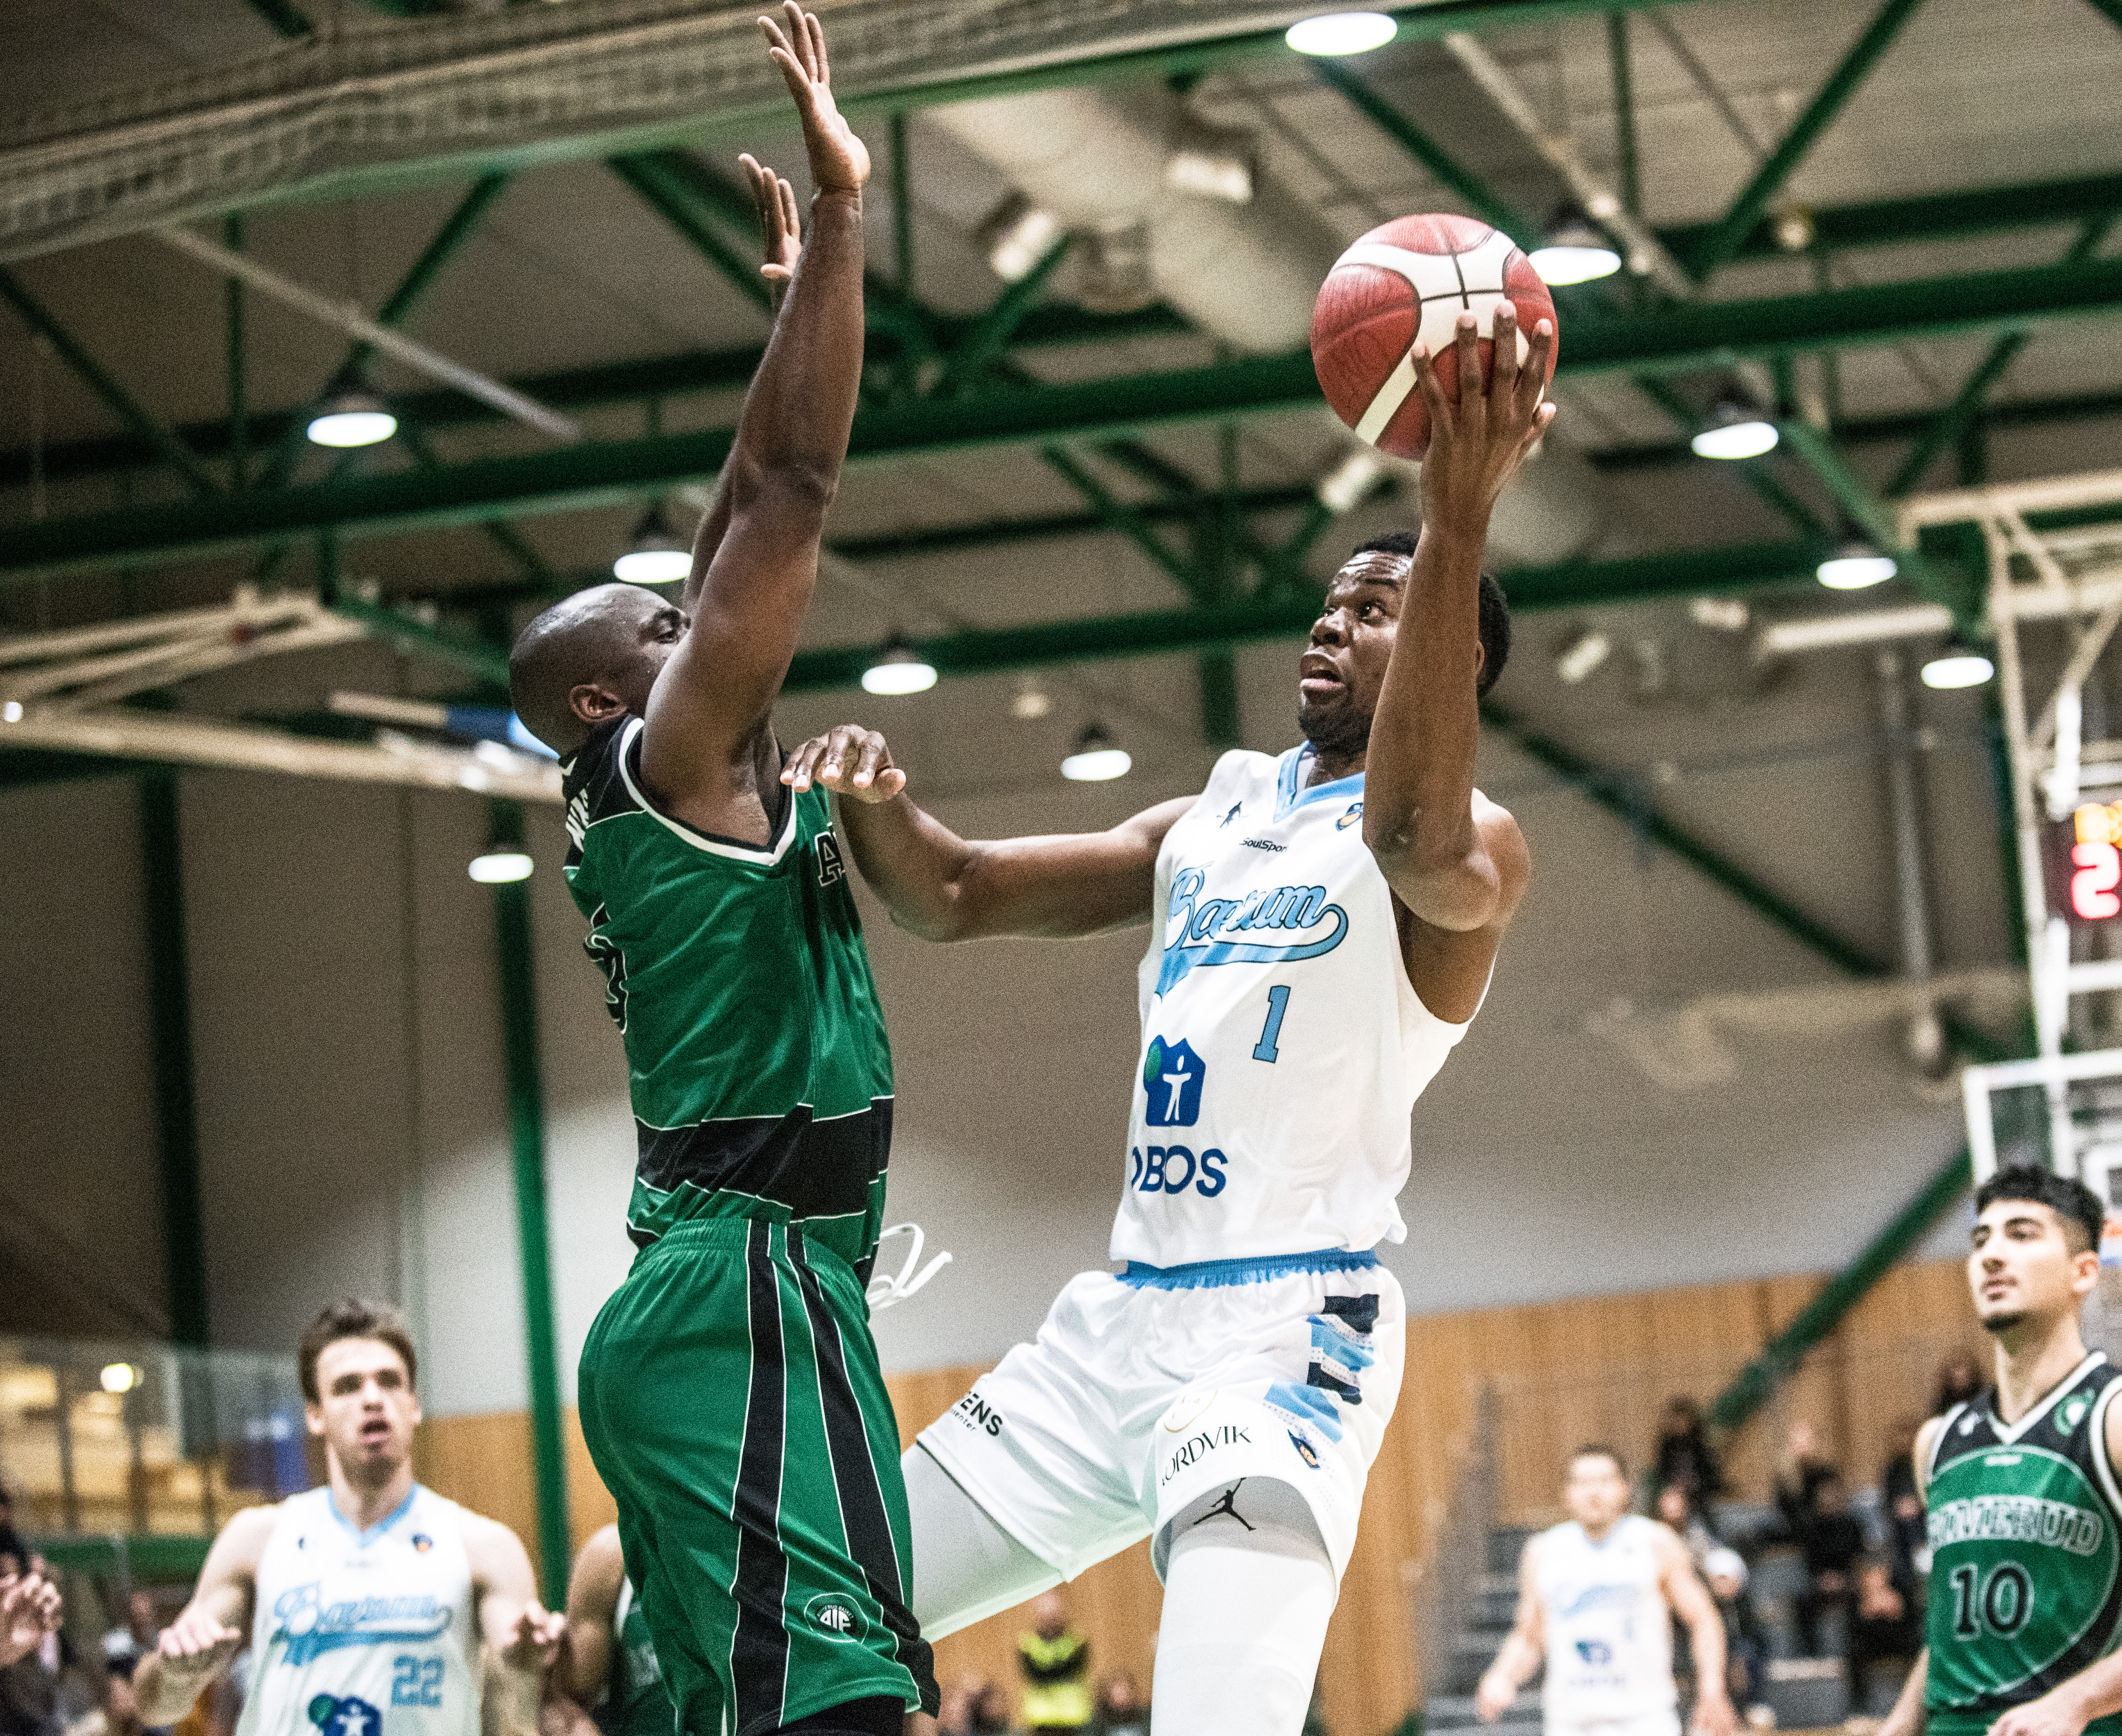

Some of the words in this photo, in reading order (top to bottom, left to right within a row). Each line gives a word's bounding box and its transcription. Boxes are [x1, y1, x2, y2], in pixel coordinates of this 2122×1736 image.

[1239, 837, 1288, 853] SoulSpor
[1253, 985, 1291, 1063] 1
[1949, 1560, 2035, 1641] 10
[391, 1653, 446, 1708] 22
